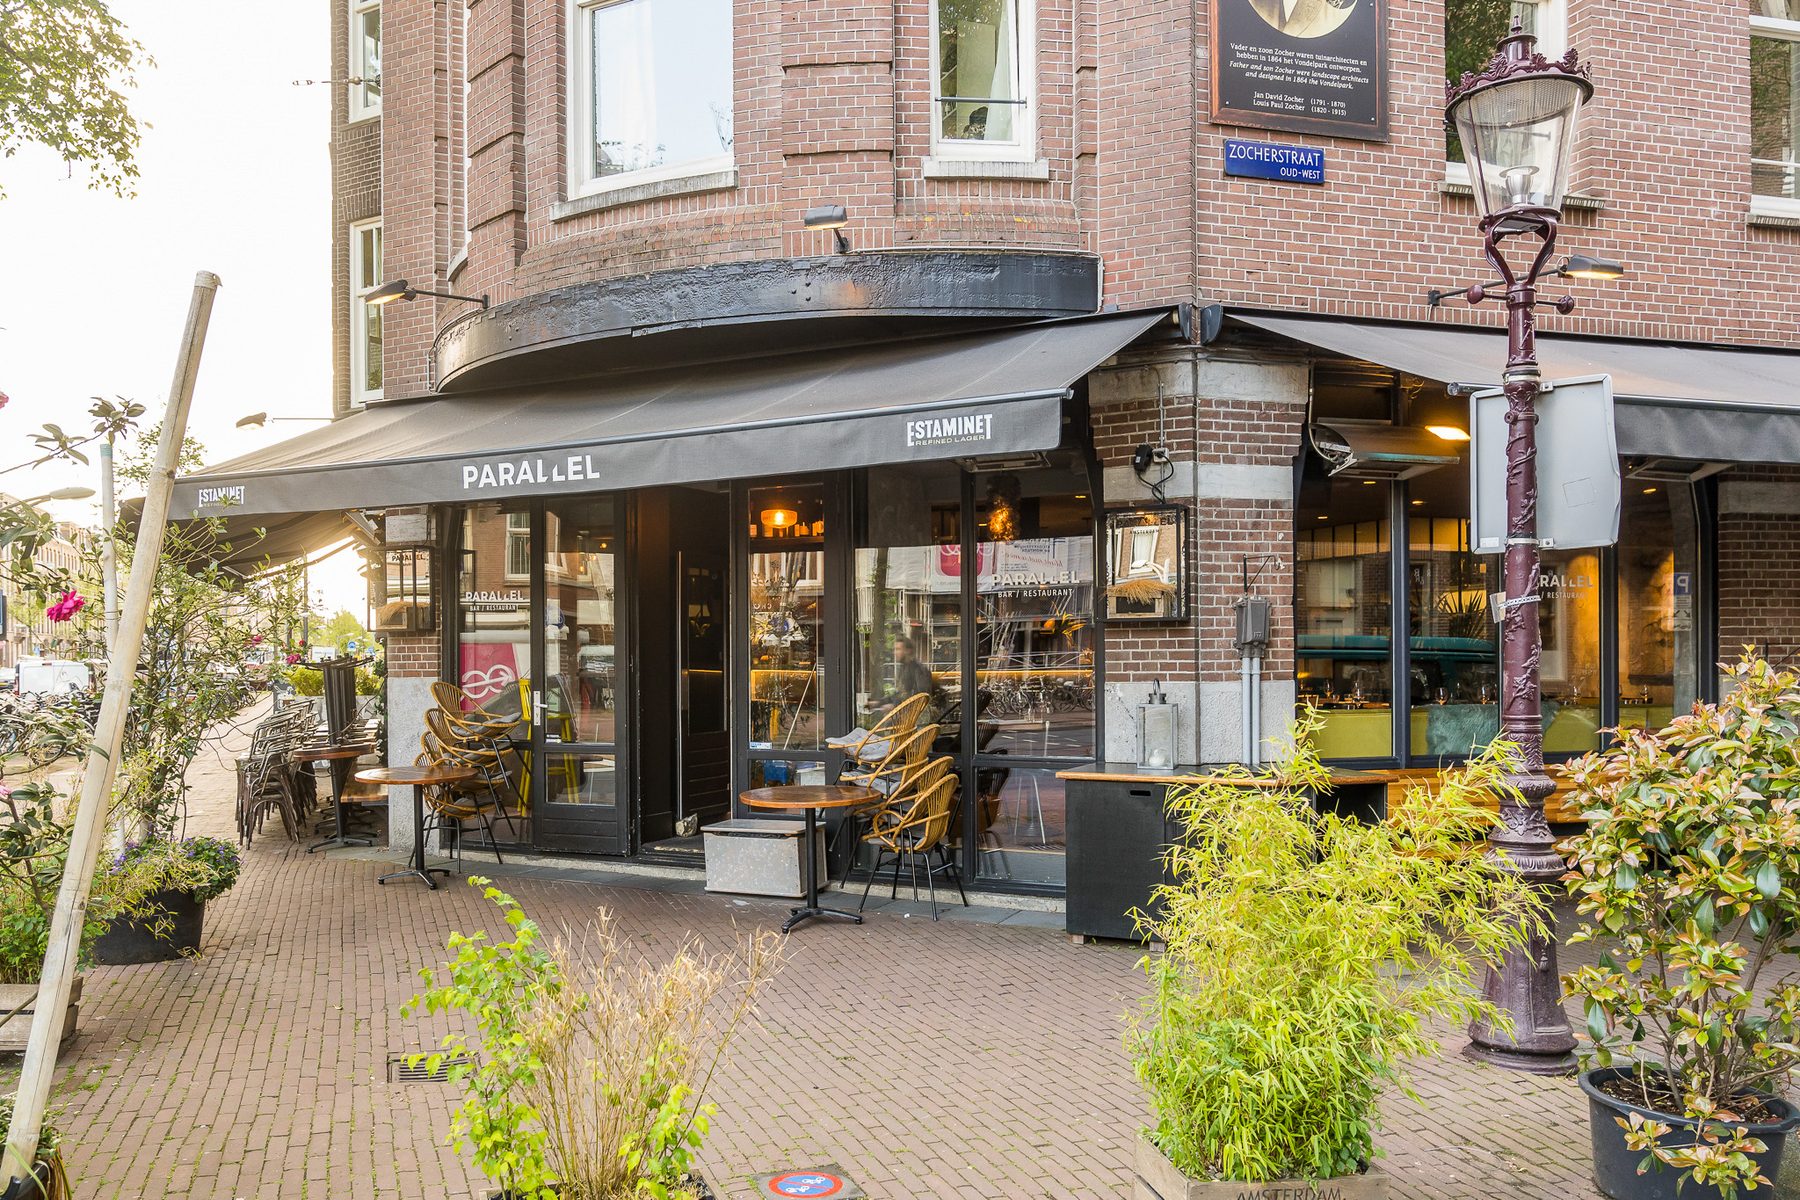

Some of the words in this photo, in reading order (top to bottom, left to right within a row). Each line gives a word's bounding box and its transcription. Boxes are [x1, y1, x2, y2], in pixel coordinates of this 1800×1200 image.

[1230, 42, 1248, 51] Vader
[1274, 48, 1295, 57] Zocher
[1296, 52, 1314, 60] waren
[1236, 51, 1259, 60] hebben
[1267, 55, 1282, 63] 1864
[1283, 57, 1293, 65] het
[1294, 58, 1328, 69] Vondelpark
[1229, 60, 1249, 69] Father
[1250, 63, 1262, 71] and
[1275, 66, 1295, 75] Zocher
[1296, 69, 1310, 77] were
[1311, 70, 1340, 81] landscape
[1341, 75, 1369, 84] architects
[1258, 72, 1285, 81] designed
[1293, 76, 1308, 84] 1864
[1253, 91, 1264, 99] Jan
[1265, 92, 1283, 101] David
[1283, 94, 1304, 104] Zocher
[1310, 98, 1326, 106] (1791
[1331, 100, 1346, 108] 1870)
[1253, 99, 1269, 107] Louis
[1270, 100, 1284, 109] Paul
[1284, 103, 1305, 111] Zocher
[1311, 106, 1327, 114] (1820
[1331, 108, 1347, 116] 1915)
[1229, 144, 1320, 167] ZOCHERSTRAAT
[1280, 167, 1320, 179] OUD-WEST
[906, 413, 993, 447] ESTAMINET
[915, 437, 953, 446] REFINED
[954, 434, 985, 443] LAGER
[462, 454, 600, 489] PARALLEL
[198, 485, 245, 508] ESTAMINET
[992, 570, 1080, 587] PARALLEL
[1540, 574, 1595, 588] RALLEL
[465, 590, 524, 602] PARALLEL
[998, 590, 1014, 598] BAR
[1023, 588, 1075, 598] RESTAURANT
